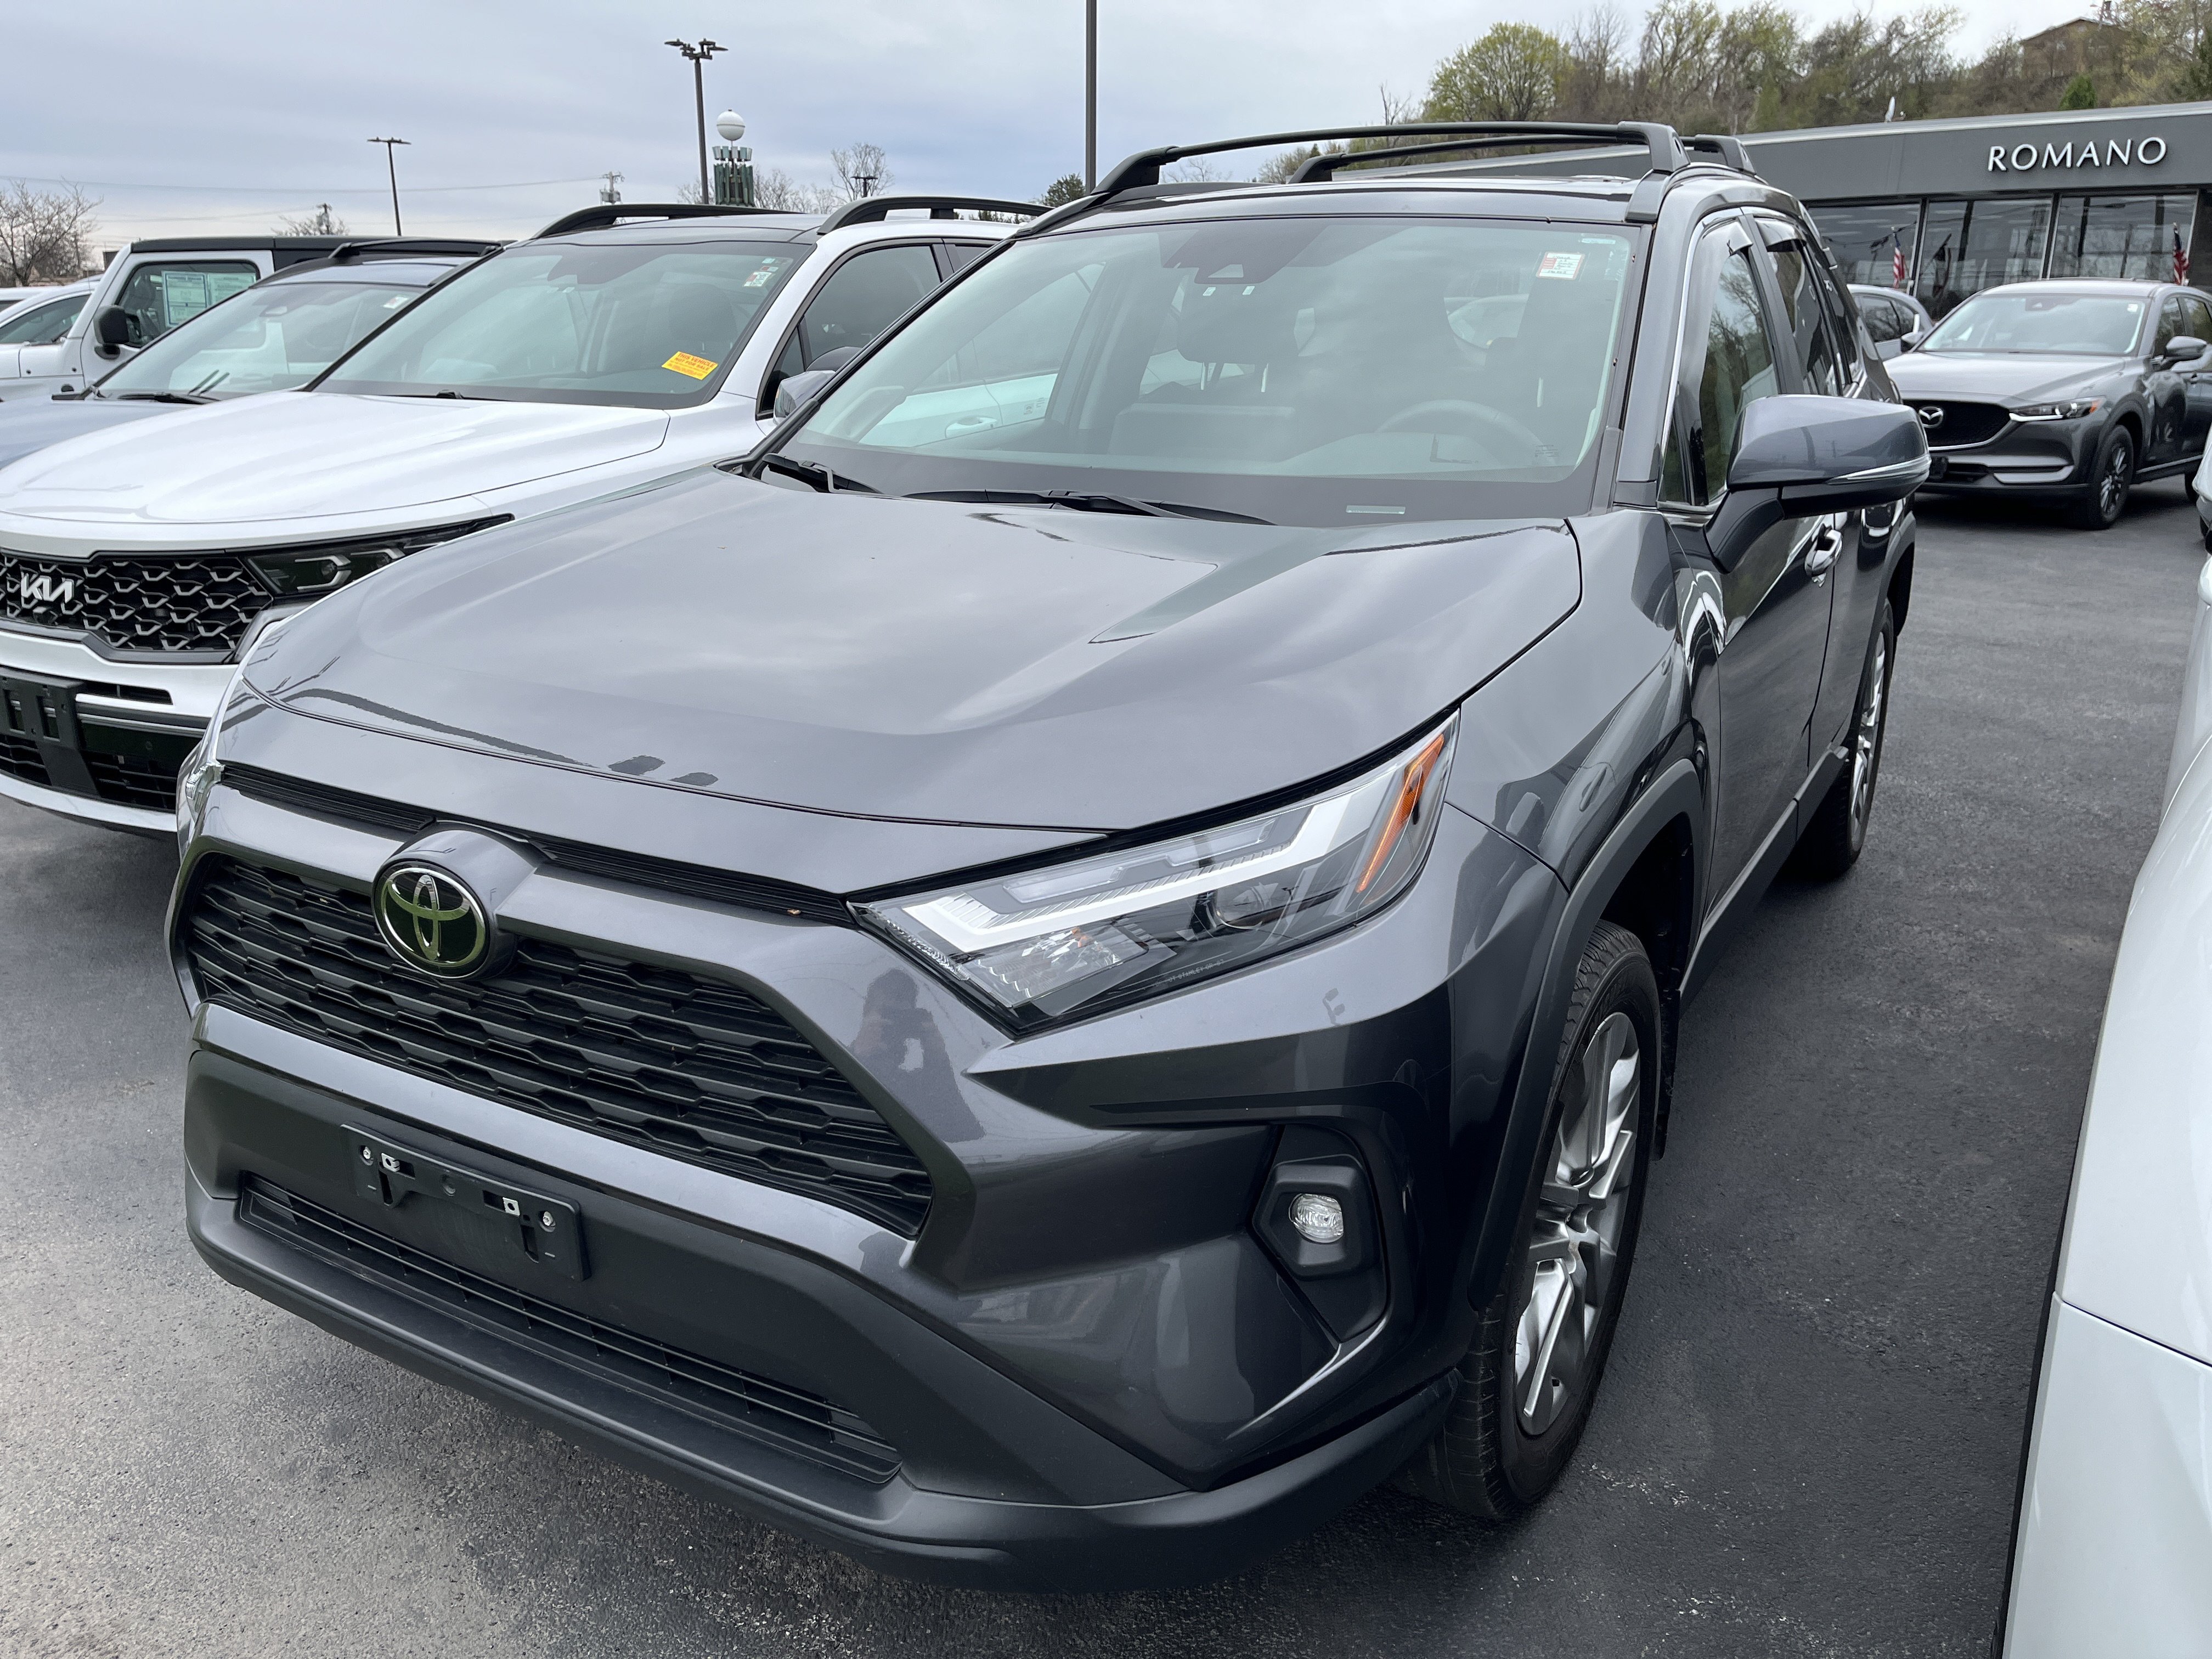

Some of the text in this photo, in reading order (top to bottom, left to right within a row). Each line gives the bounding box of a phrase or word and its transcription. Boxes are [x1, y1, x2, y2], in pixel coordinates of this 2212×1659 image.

[1988, 137, 2166, 172] ROMANO
[691, 356, 716, 368] VEHICLE
[20, 573, 75, 603] KIA
